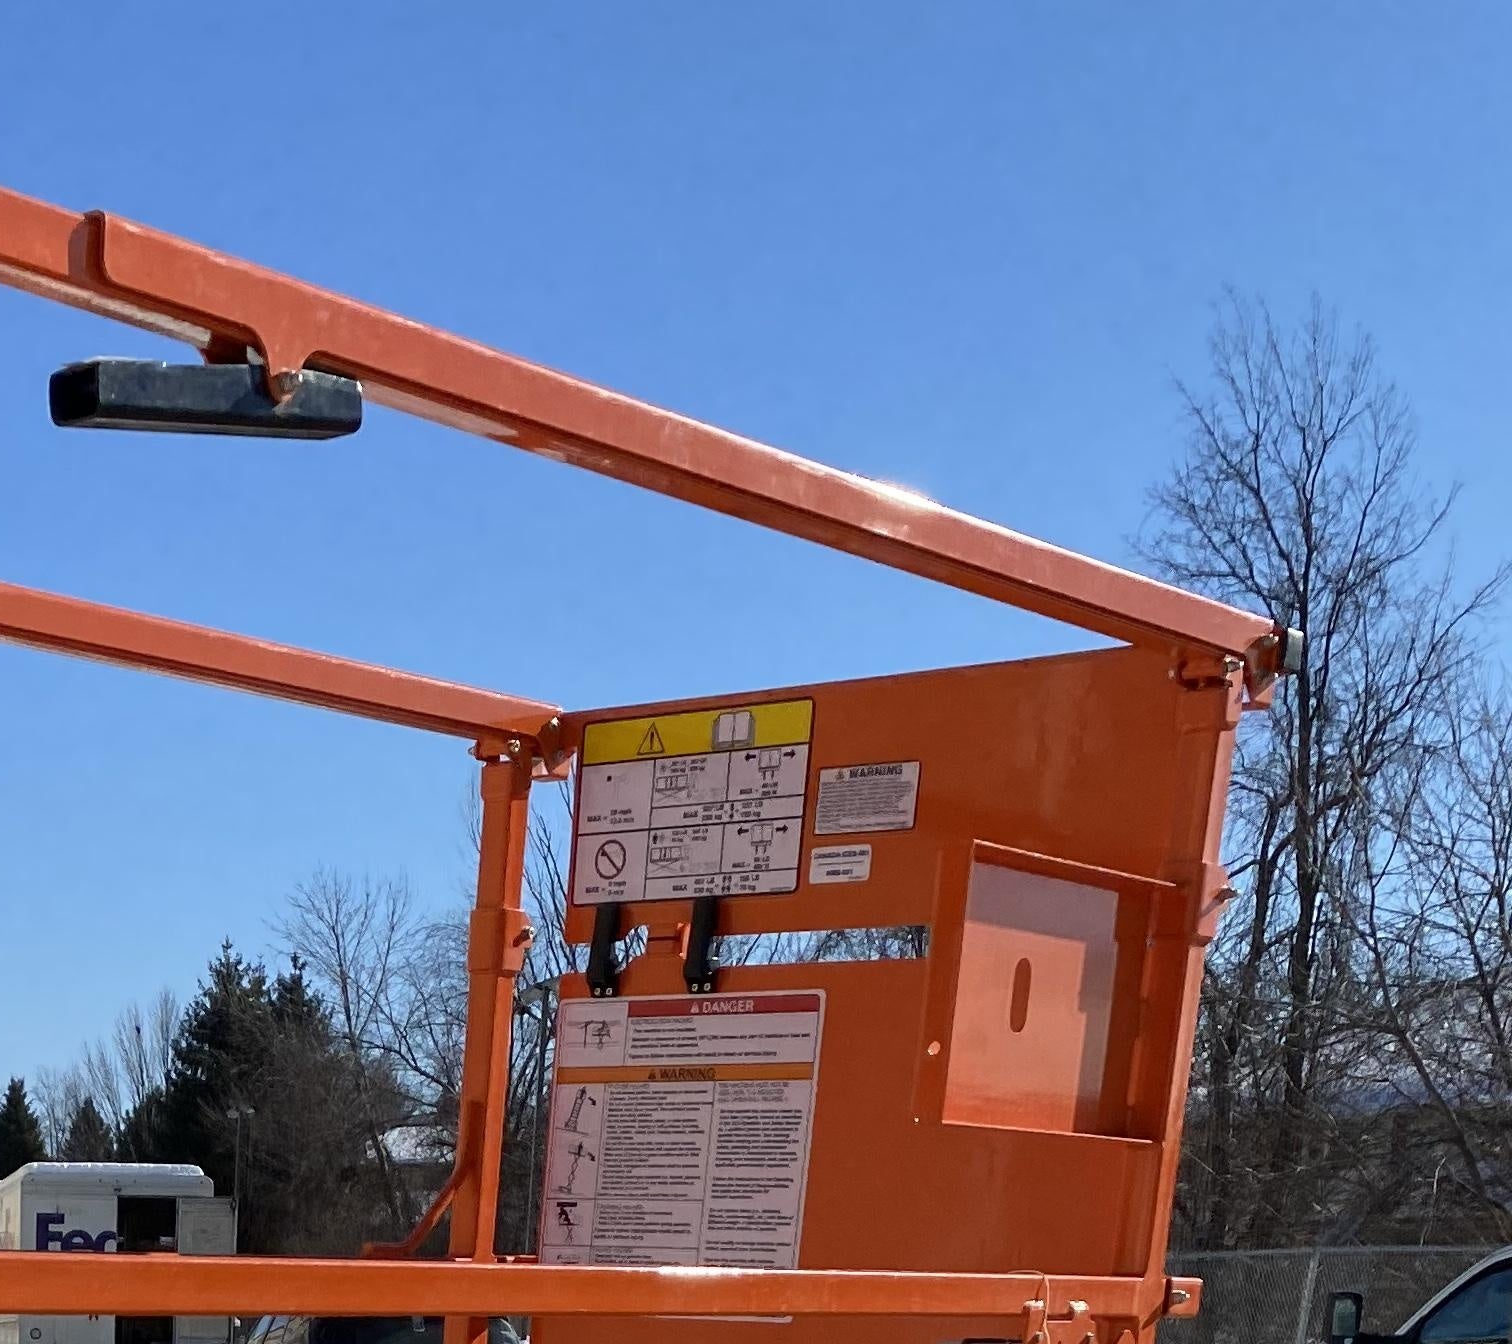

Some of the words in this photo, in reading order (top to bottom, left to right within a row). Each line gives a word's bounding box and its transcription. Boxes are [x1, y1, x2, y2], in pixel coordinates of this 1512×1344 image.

[849, 765, 903, 779] WARNING
[702, 1000, 754, 1014] DANGER
[659, 1068, 716, 1081] WARNING
